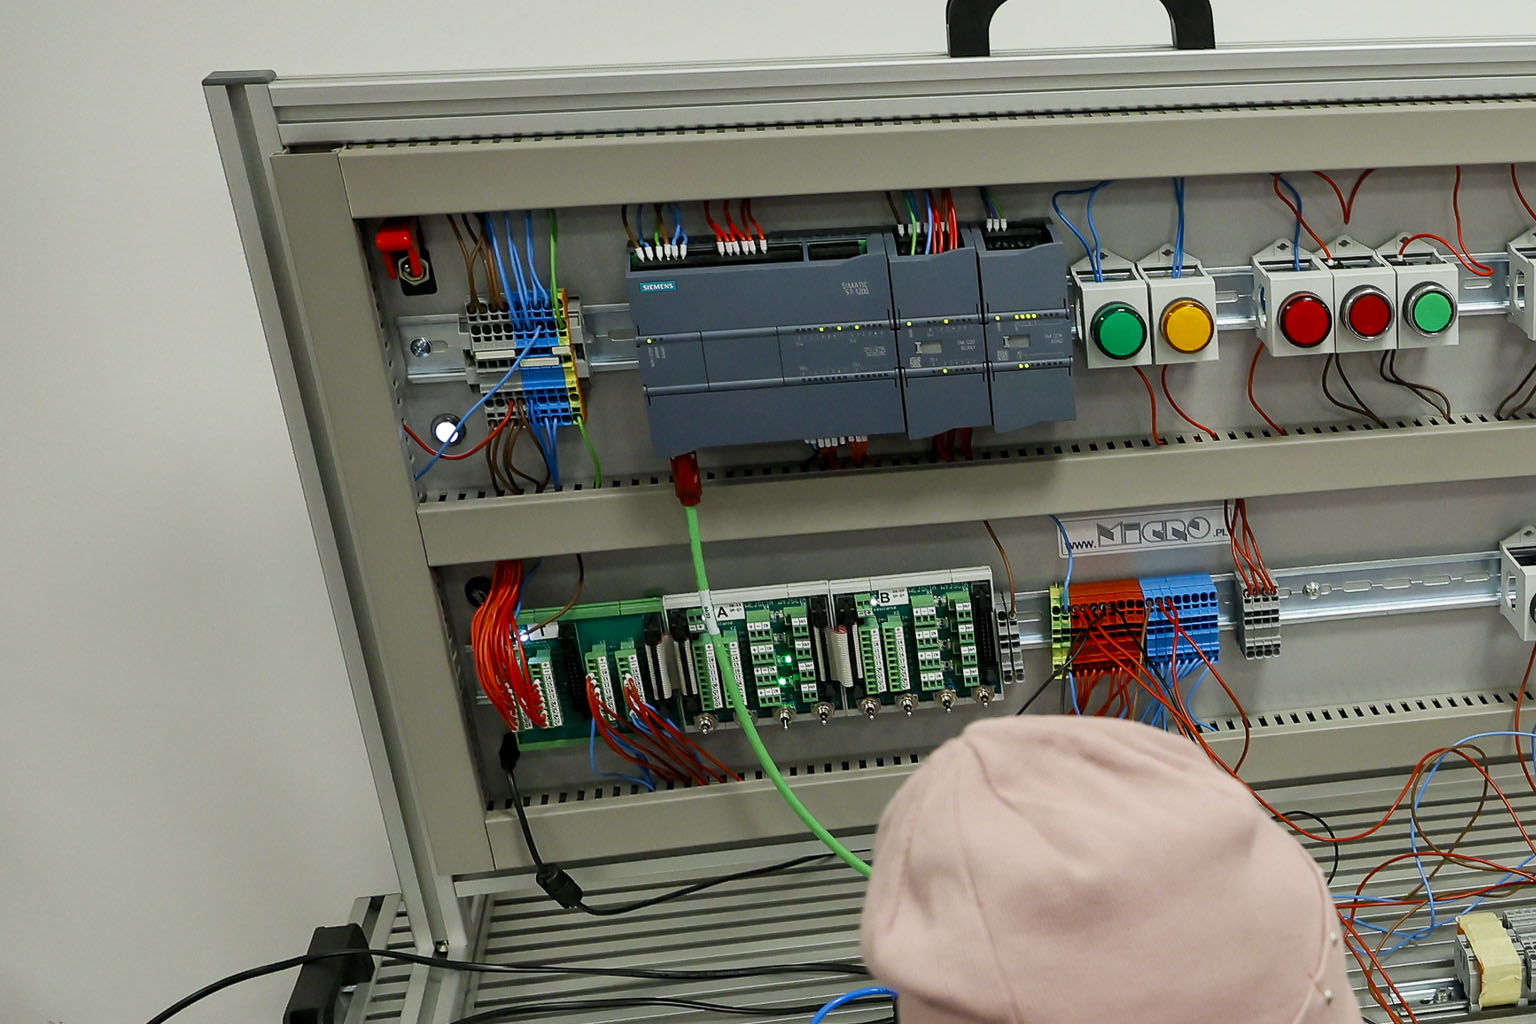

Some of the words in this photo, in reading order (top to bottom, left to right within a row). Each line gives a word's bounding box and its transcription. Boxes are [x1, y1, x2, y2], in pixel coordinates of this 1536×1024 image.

[642, 282, 674, 291] SIEMENS
[842, 282, 868, 290] SIMATIC
[880, 592, 890, 603] B
[718, 606, 728, 618] A
